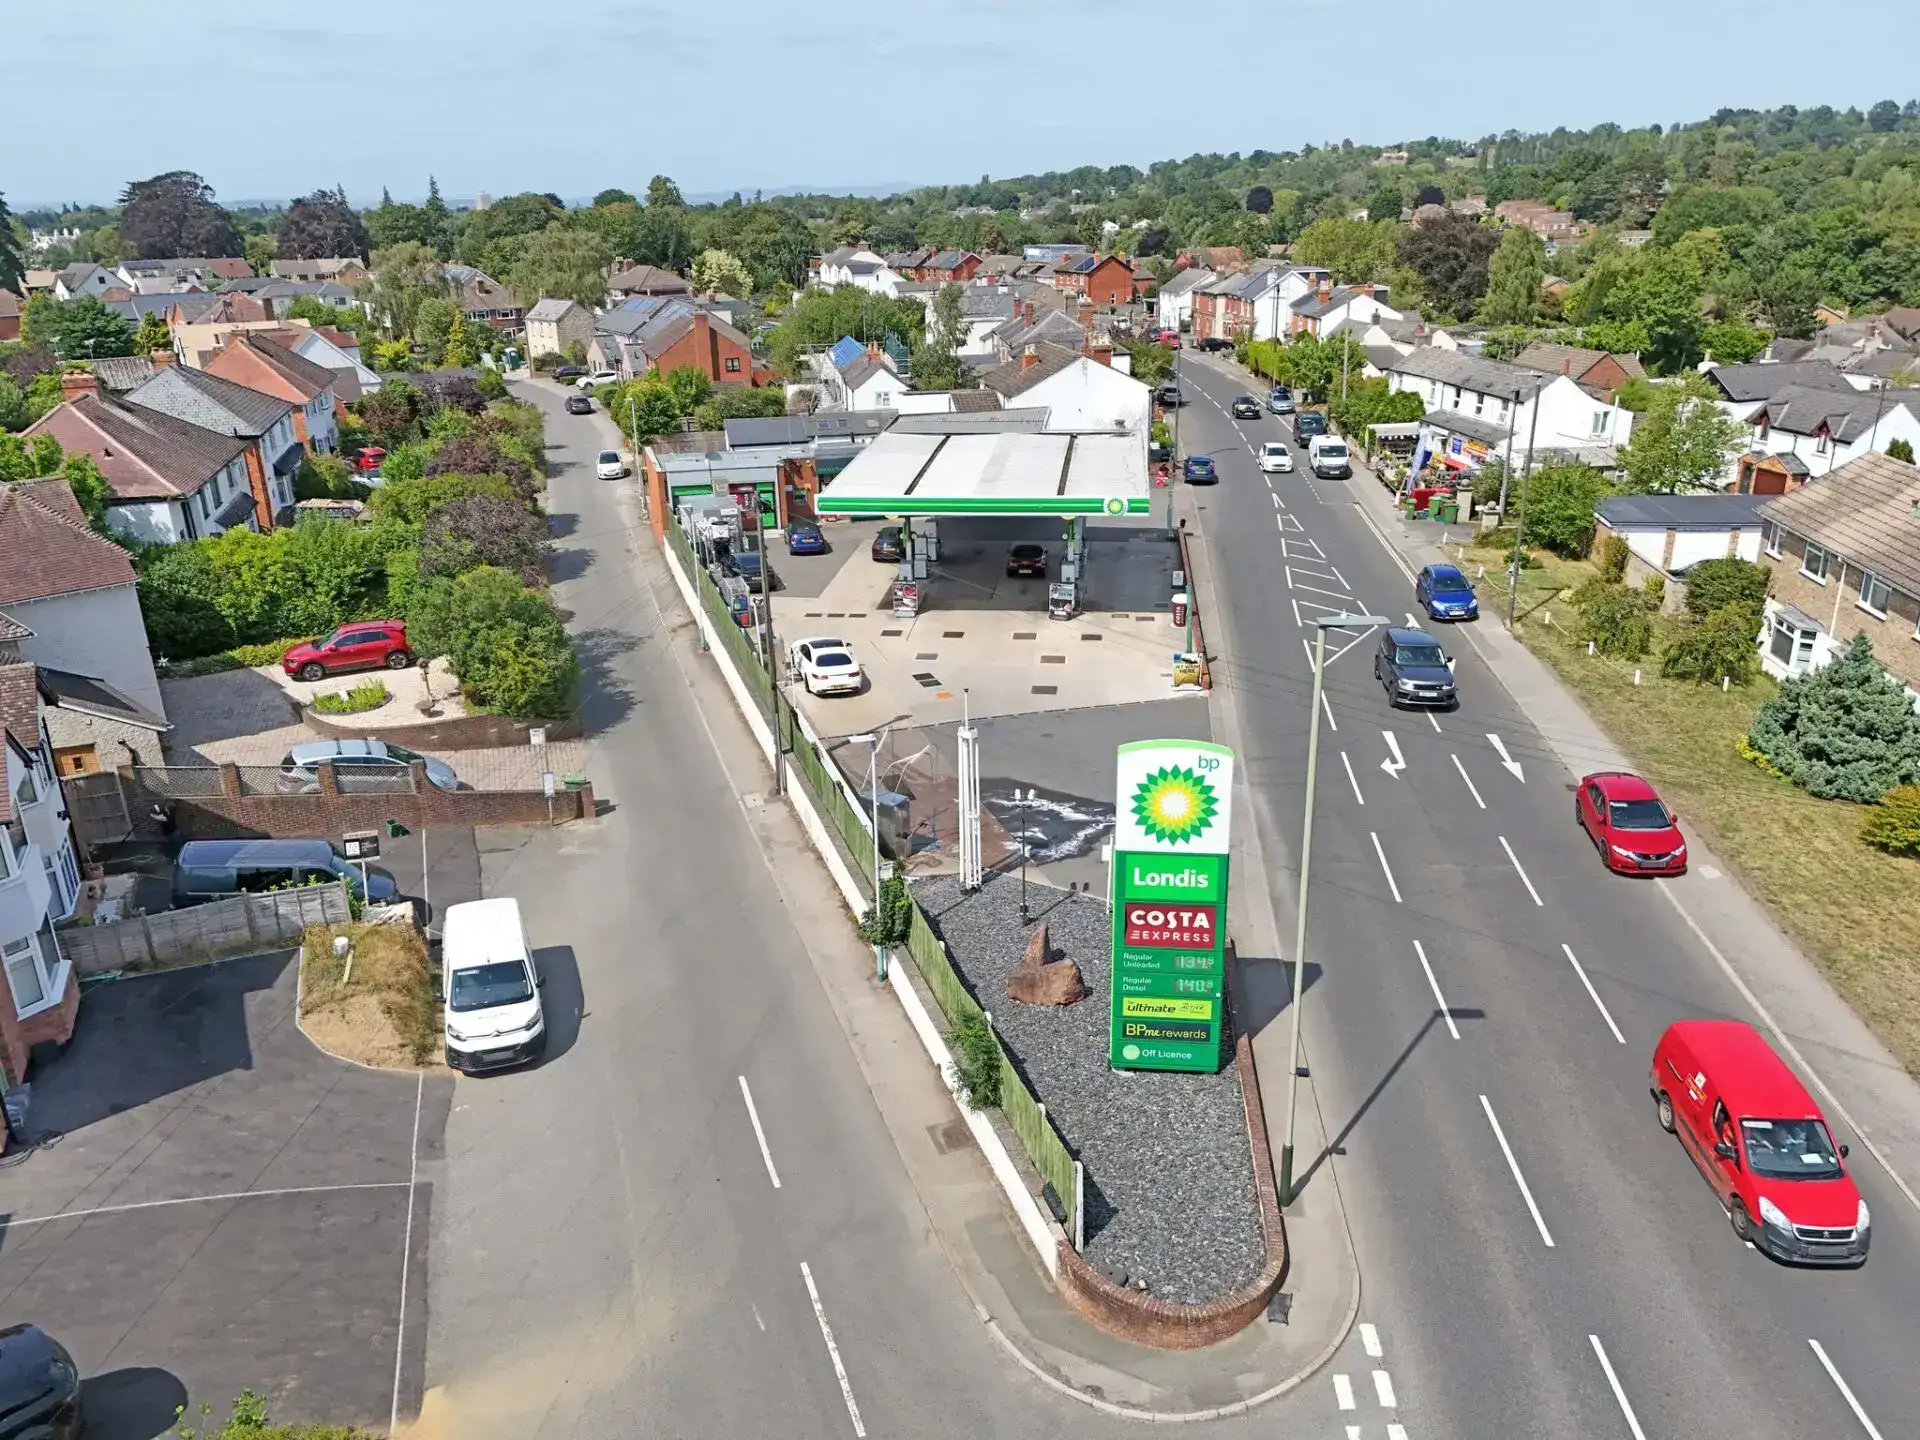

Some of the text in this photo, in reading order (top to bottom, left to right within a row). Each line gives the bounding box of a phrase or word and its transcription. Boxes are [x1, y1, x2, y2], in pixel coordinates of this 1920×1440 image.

[1198, 755, 1220, 772] bp
[1133, 867, 1209, 888] Londis
[1130, 909, 1210, 929] COSTA
[1142, 930, 1210, 943] EXPRESS
[1123, 952, 1153, 961] Regular
[1123, 961, 1160, 969] Unleaded
[1122, 976, 1152, 984] Regular
[1122, 983, 1147, 991] Diesel
[1127, 1003, 1176, 1014] ultimate
[1141, 1049, 1192, 1059] Off Licence
